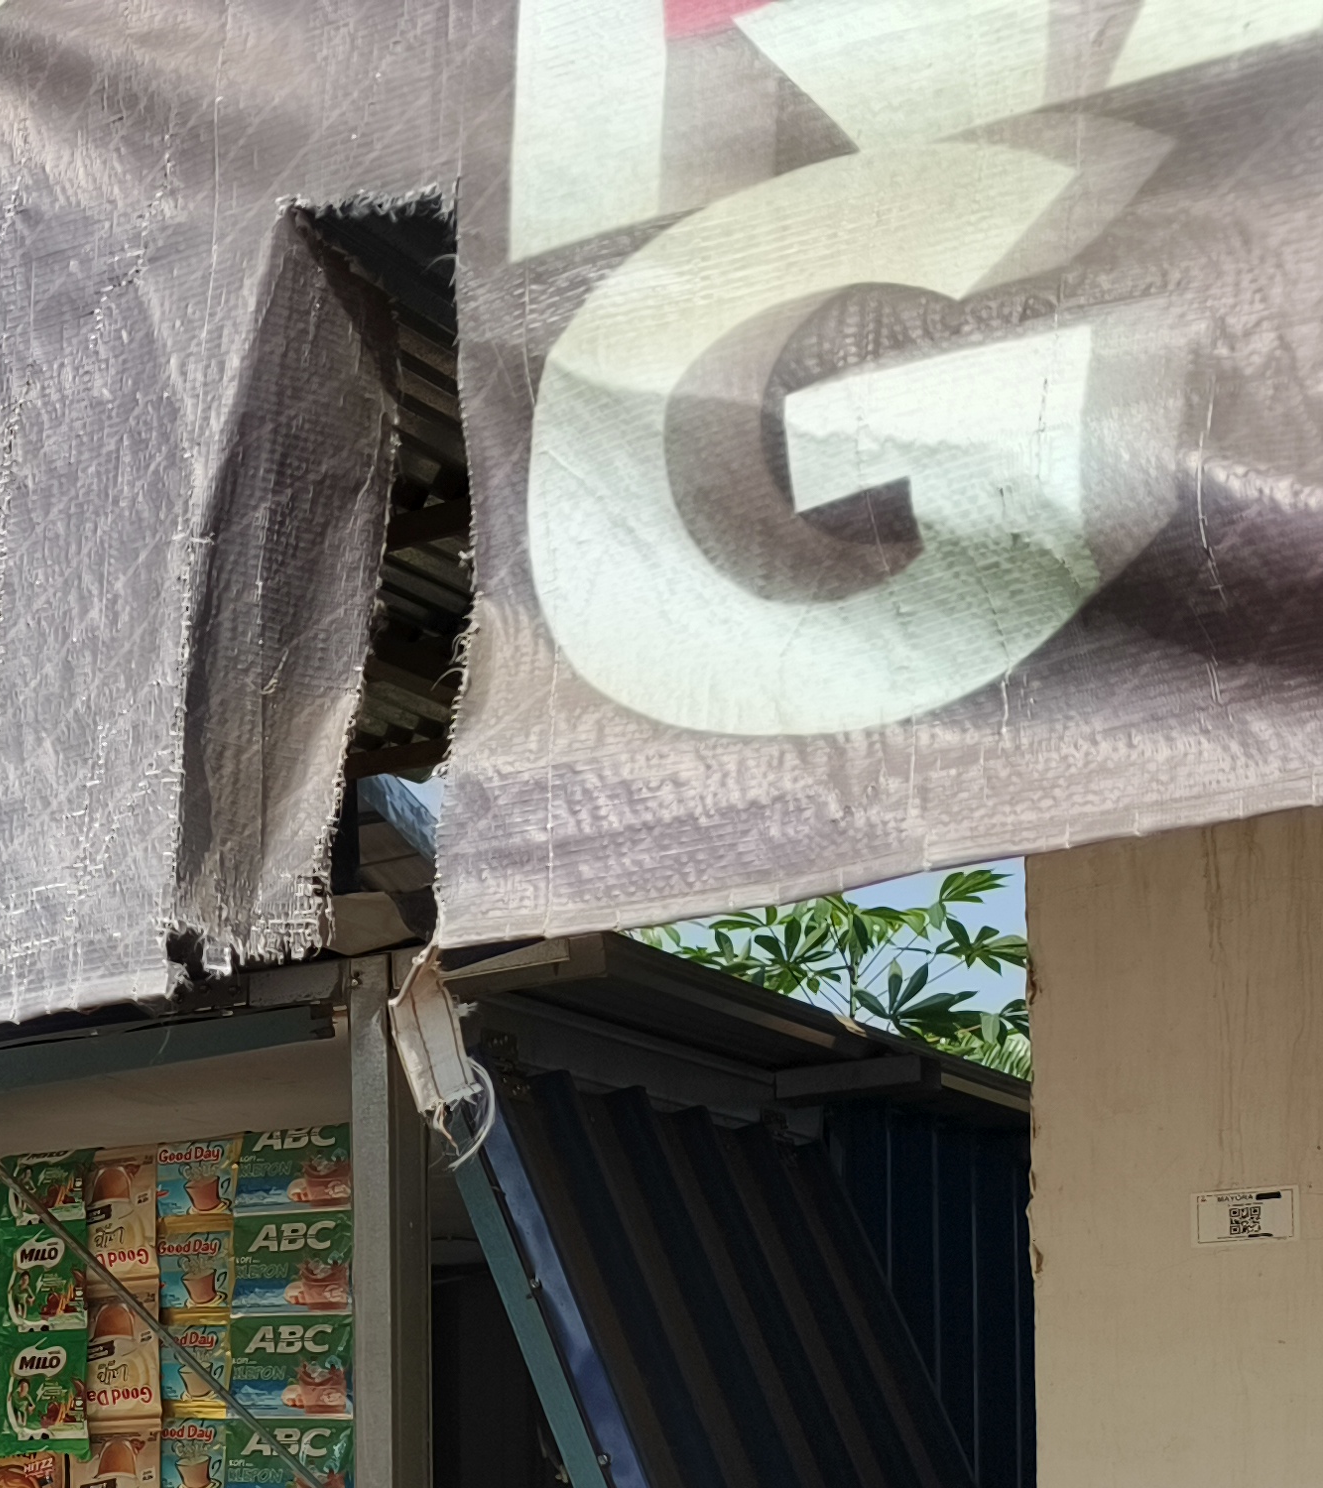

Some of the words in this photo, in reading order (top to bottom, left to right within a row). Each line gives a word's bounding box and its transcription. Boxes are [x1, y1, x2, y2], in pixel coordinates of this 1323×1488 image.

[158, 1148, 193, 1164] Good
[194, 1146, 222, 1162] Day
[247, 1220, 336, 1253] ABC
[19, 1246, 59, 1264] MILO
[158, 1240, 193, 1256] Good
[193, 1238, 220, 1255] Day
[244, 1324, 333, 1354] ABC
[18, 1355, 61, 1371] MILO
[111, 1386, 153, 1404] Good
[186, 1423, 214, 1442] Day
[240, 1427, 332, 1457] ABC
